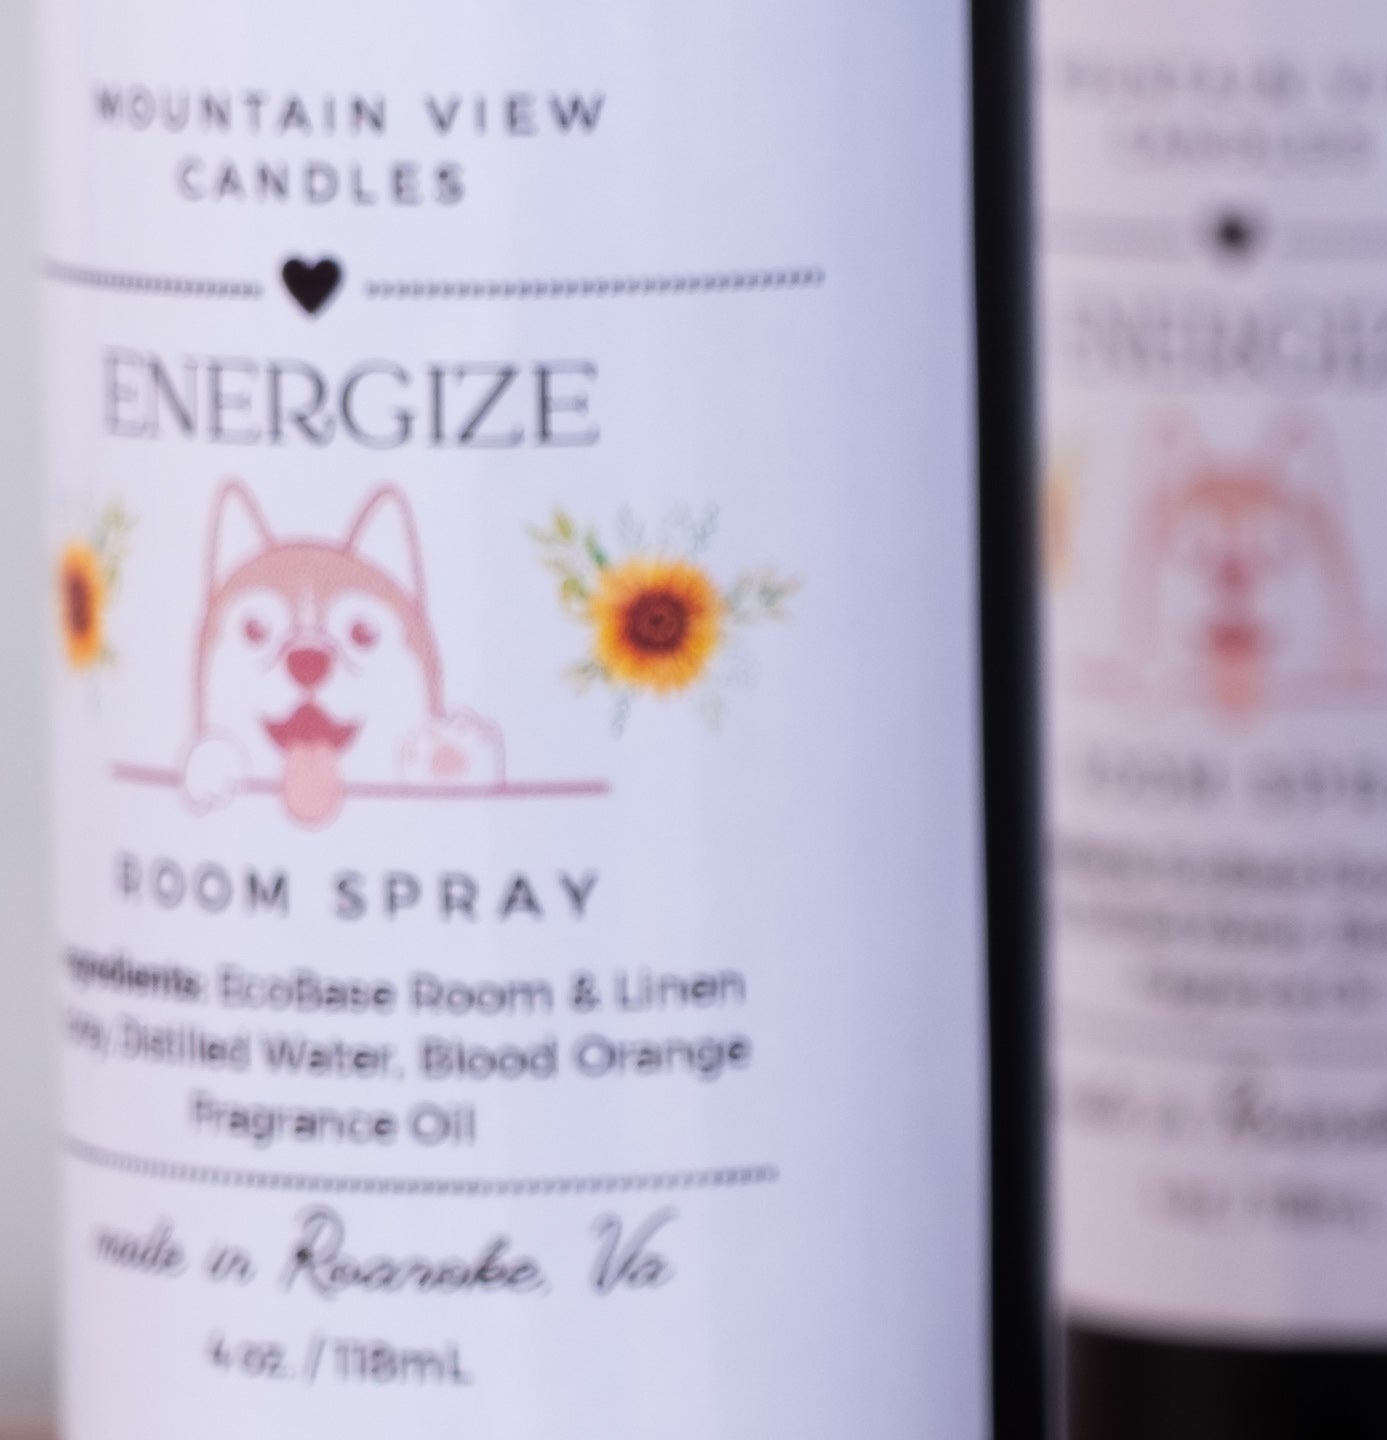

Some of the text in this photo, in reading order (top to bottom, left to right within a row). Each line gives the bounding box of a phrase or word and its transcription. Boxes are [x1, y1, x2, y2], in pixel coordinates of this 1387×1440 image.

[93, 83, 606, 135] MOUNTAIN VIEW
[176, 157, 468, 204] CANDLES
[101, 346, 599, 448] ENERGIZE
[115, 851, 598, 920] ROOM SPRAY
[217, 963, 398, 1012] EcoBase
[411, 971, 554, 1015] Room
[572, 974, 601, 1011] &
[613, 965, 748, 1011] Linen
[262, 1032, 404, 1080] Water,
[417, 1034, 557, 1079] Blood
[573, 1033, 752, 1083] Orange
[189, 1087, 477, 1151] Fragrance Oil
[206, 1244, 256, 1292] in
[589, 1206, 680, 1294] Va
[333, 1342, 473, 1386] 118mL
